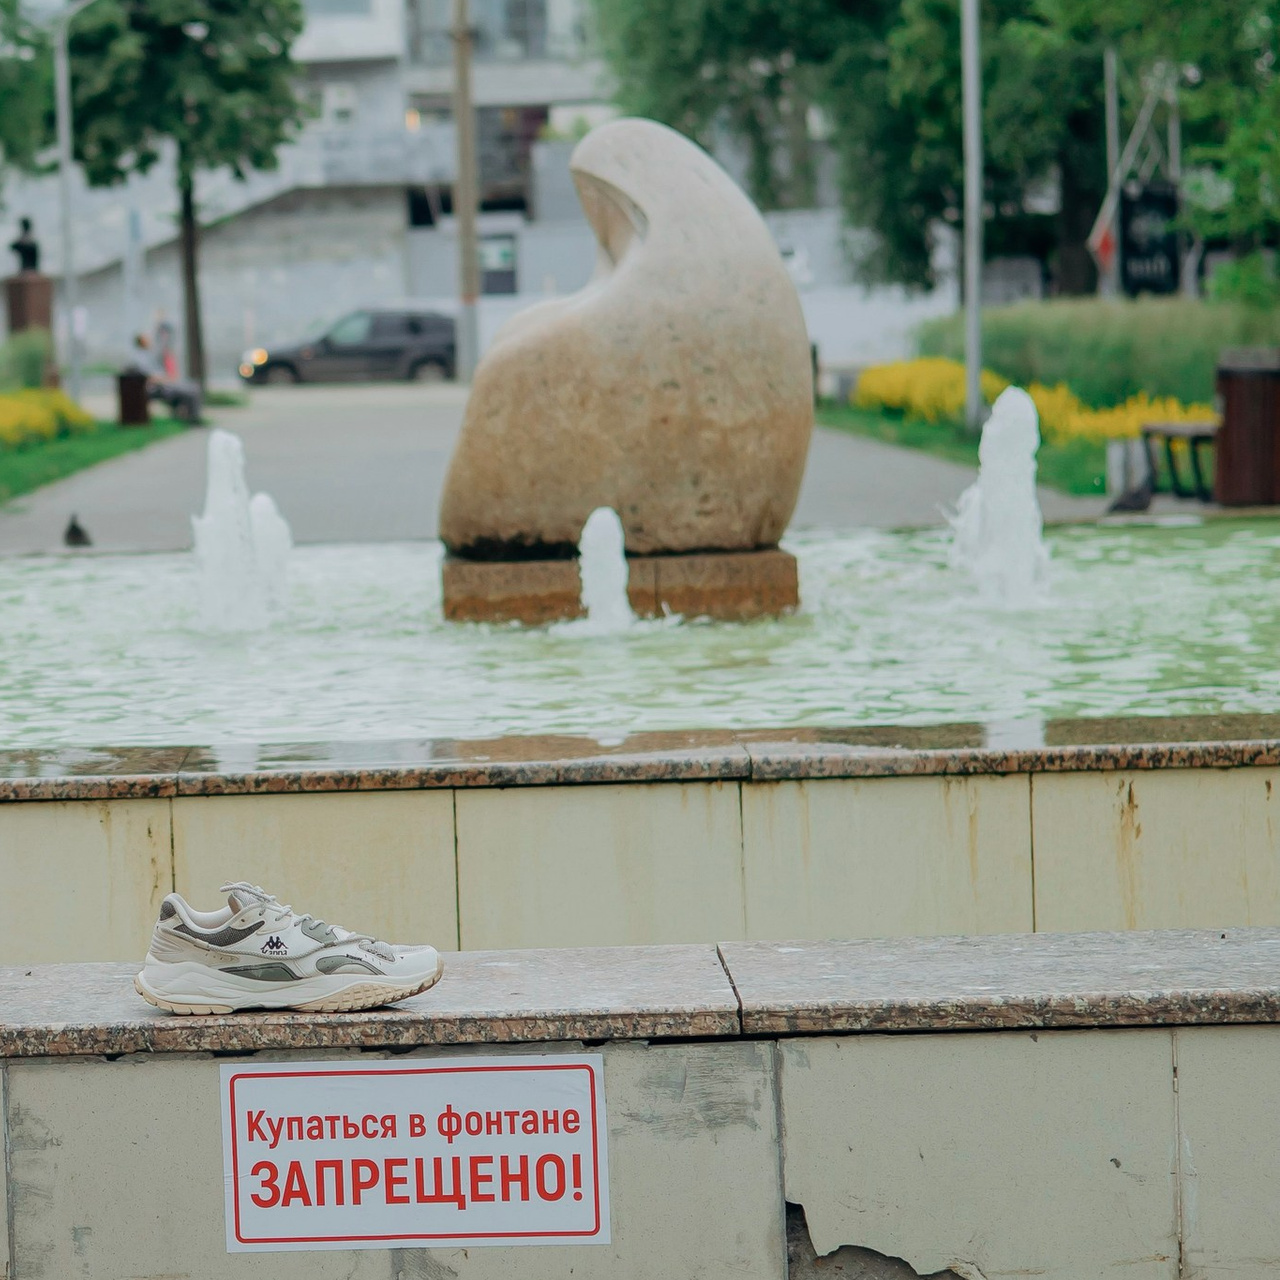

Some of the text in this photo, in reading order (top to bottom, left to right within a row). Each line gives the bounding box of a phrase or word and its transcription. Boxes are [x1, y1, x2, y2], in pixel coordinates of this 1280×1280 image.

[247, 1105, 580, 1149] Купаться в фонтане
[250, 1153, 583, 1210] ЗАПРЕЩЕНО!
